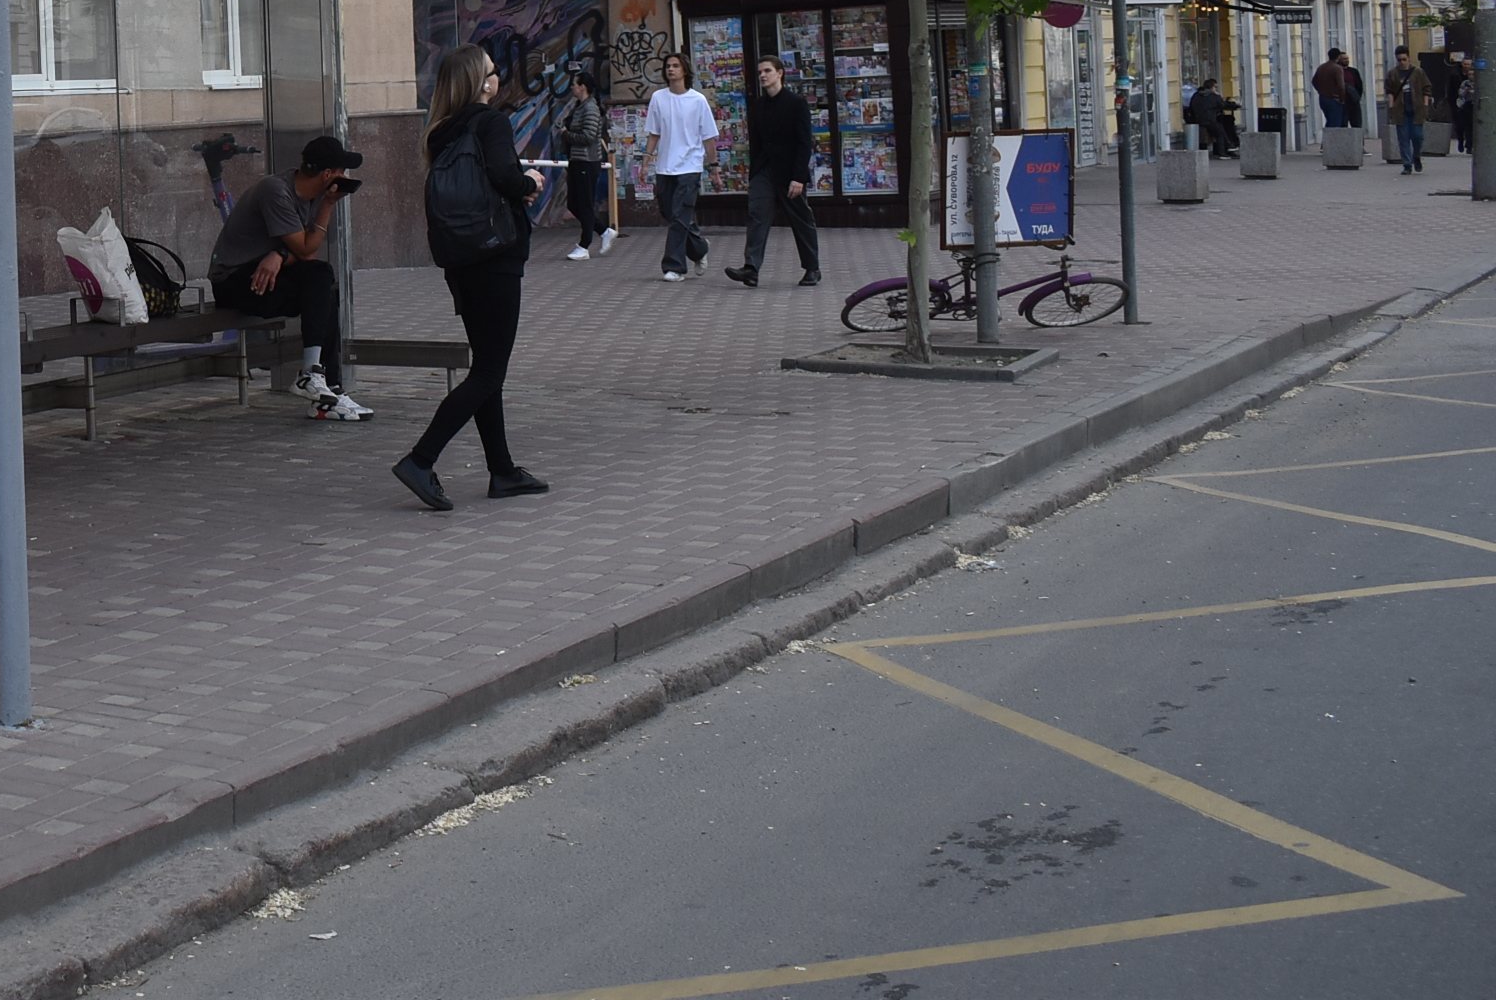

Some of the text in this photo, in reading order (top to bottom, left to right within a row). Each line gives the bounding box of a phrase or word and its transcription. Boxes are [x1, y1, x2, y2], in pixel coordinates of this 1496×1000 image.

[1026, 162, 1061, 174] БУДУ
[950, 154, 958, 226] УЛ. СУВОРОВА 12
[1032, 224, 1054, 235] ТУДА
